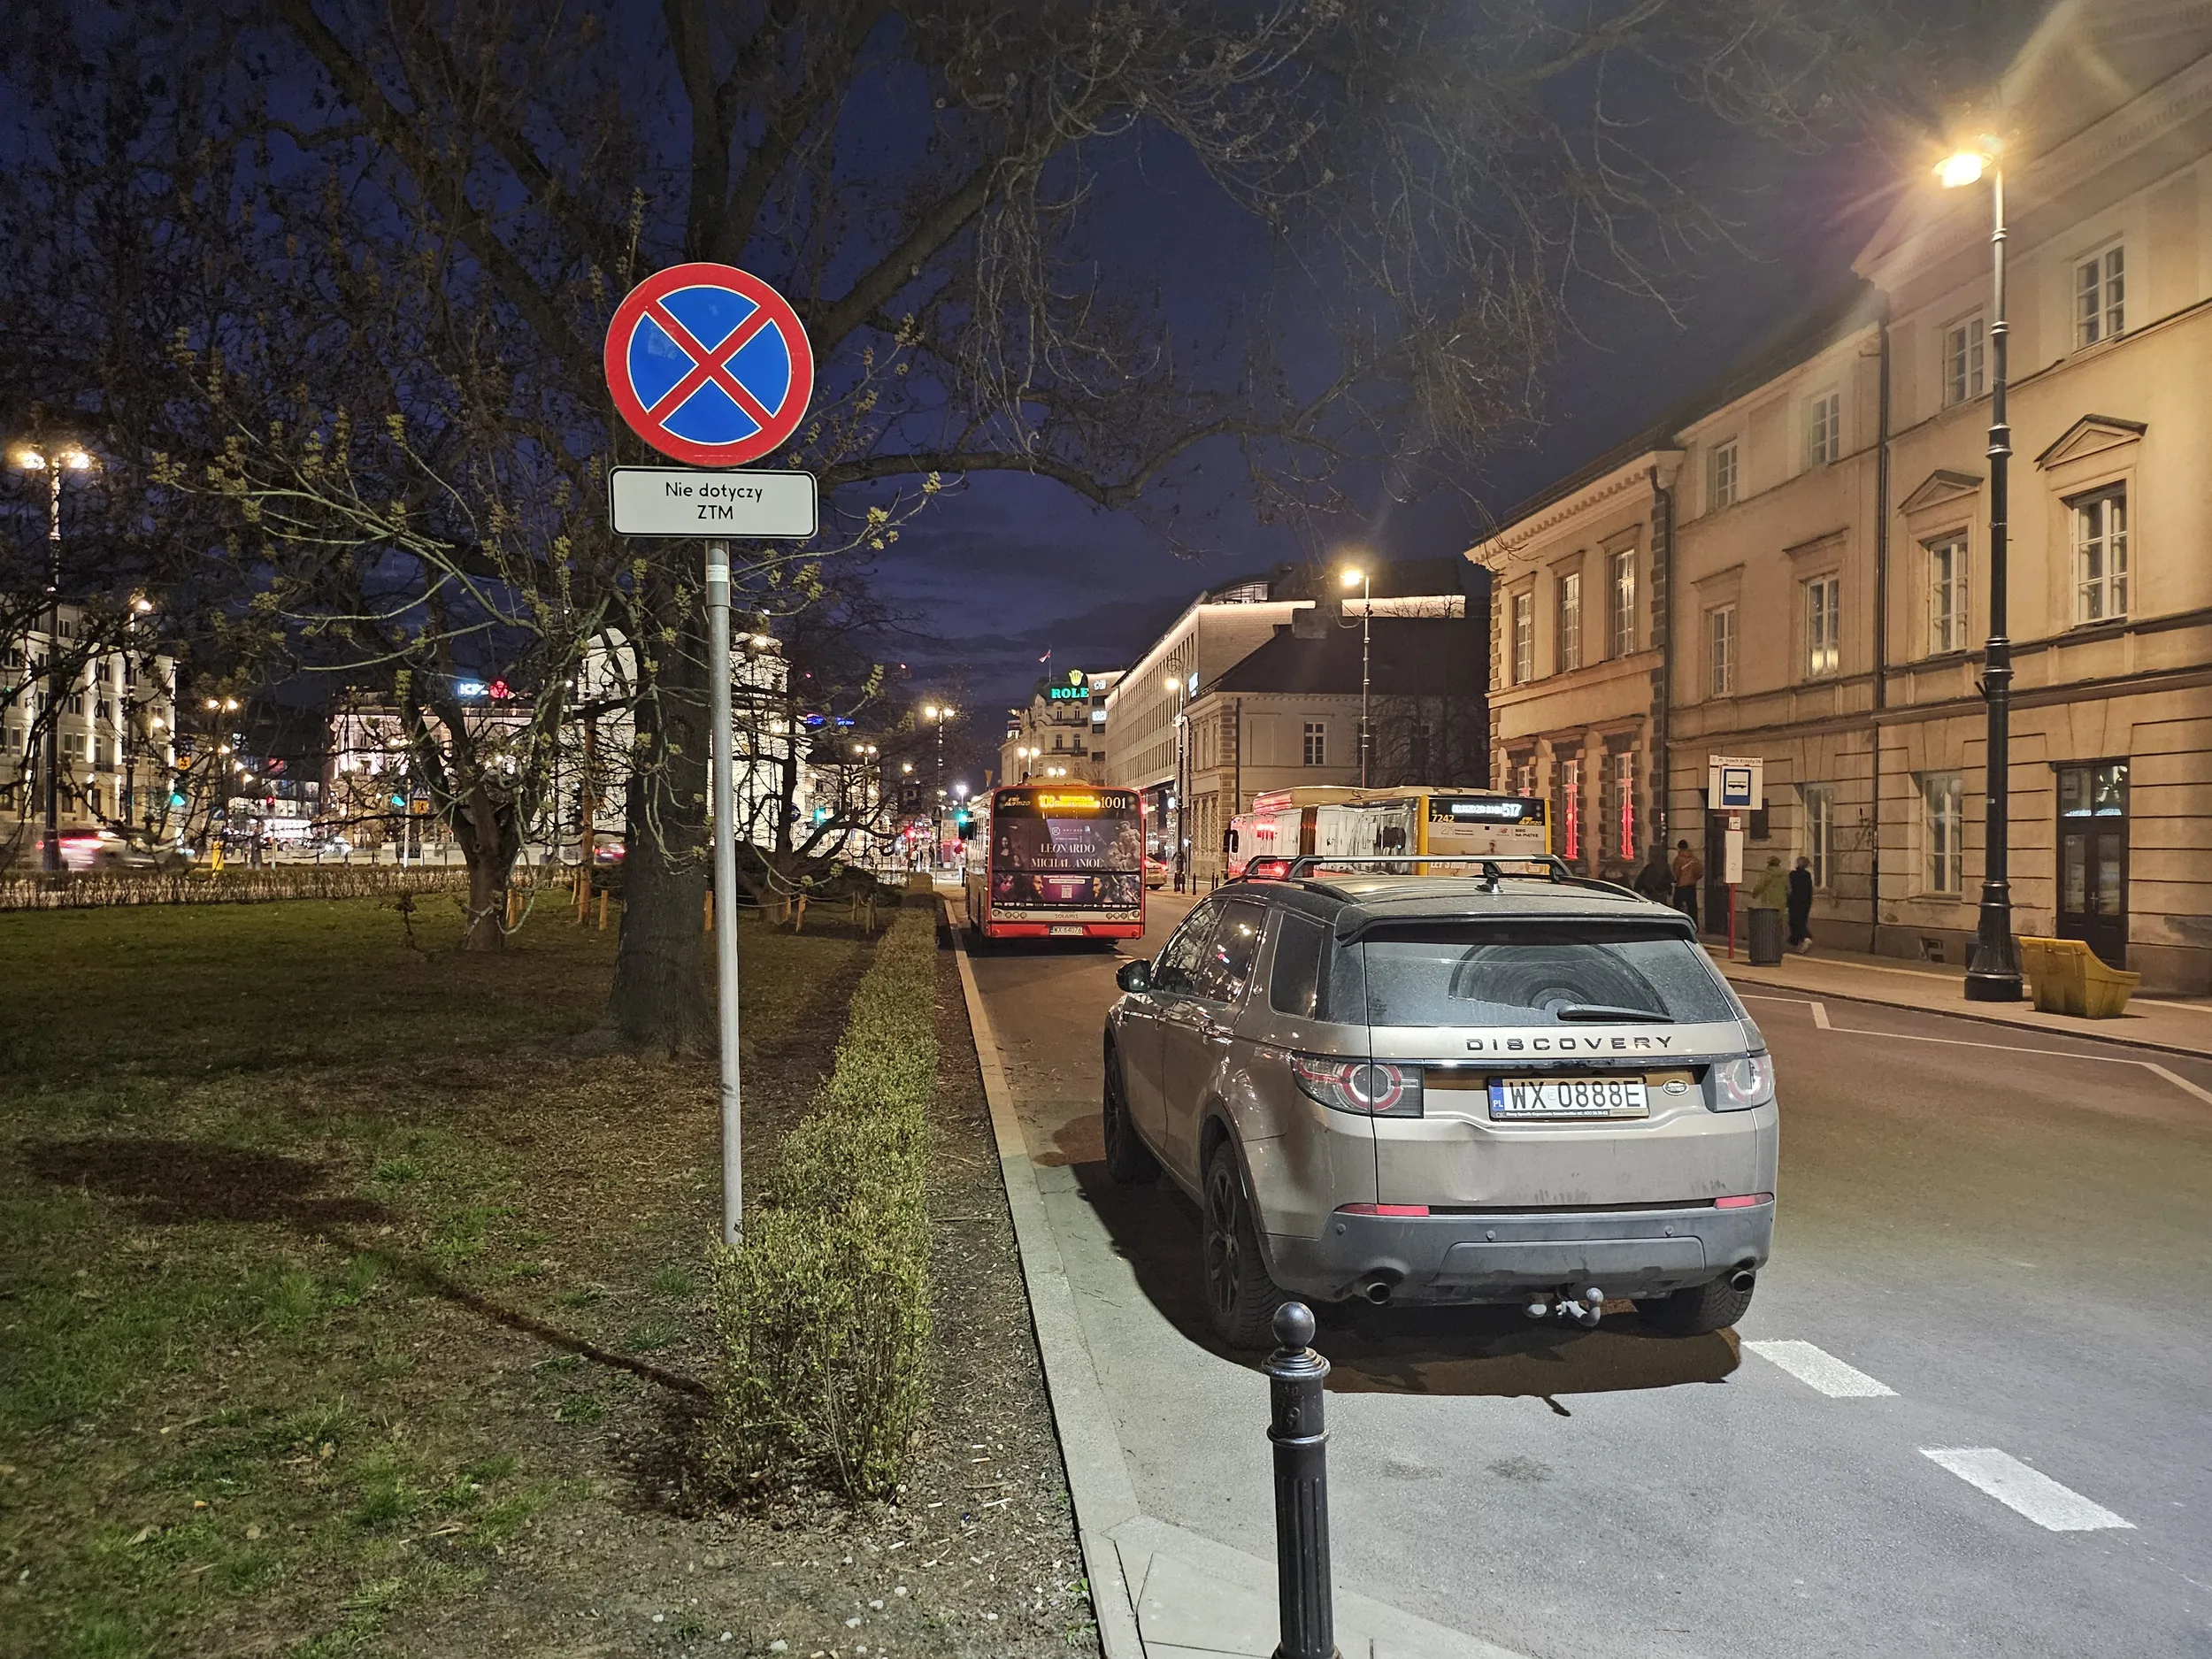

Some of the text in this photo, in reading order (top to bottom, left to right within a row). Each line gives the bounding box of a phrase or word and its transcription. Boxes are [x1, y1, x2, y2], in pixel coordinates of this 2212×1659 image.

[665, 482, 763, 503] Nie dotyczy
[697, 505, 733, 519] ZTM
[1101, 796, 1125, 809] 1001
[1502, 803, 1522, 817] 517
[1432, 814, 1455, 823] 7242
[1041, 843, 1095, 853] LEONARDO
[1466, 1036, 1672, 1051] DISCOVERY
[1509, 1080, 1640, 1109] WX 0888E
